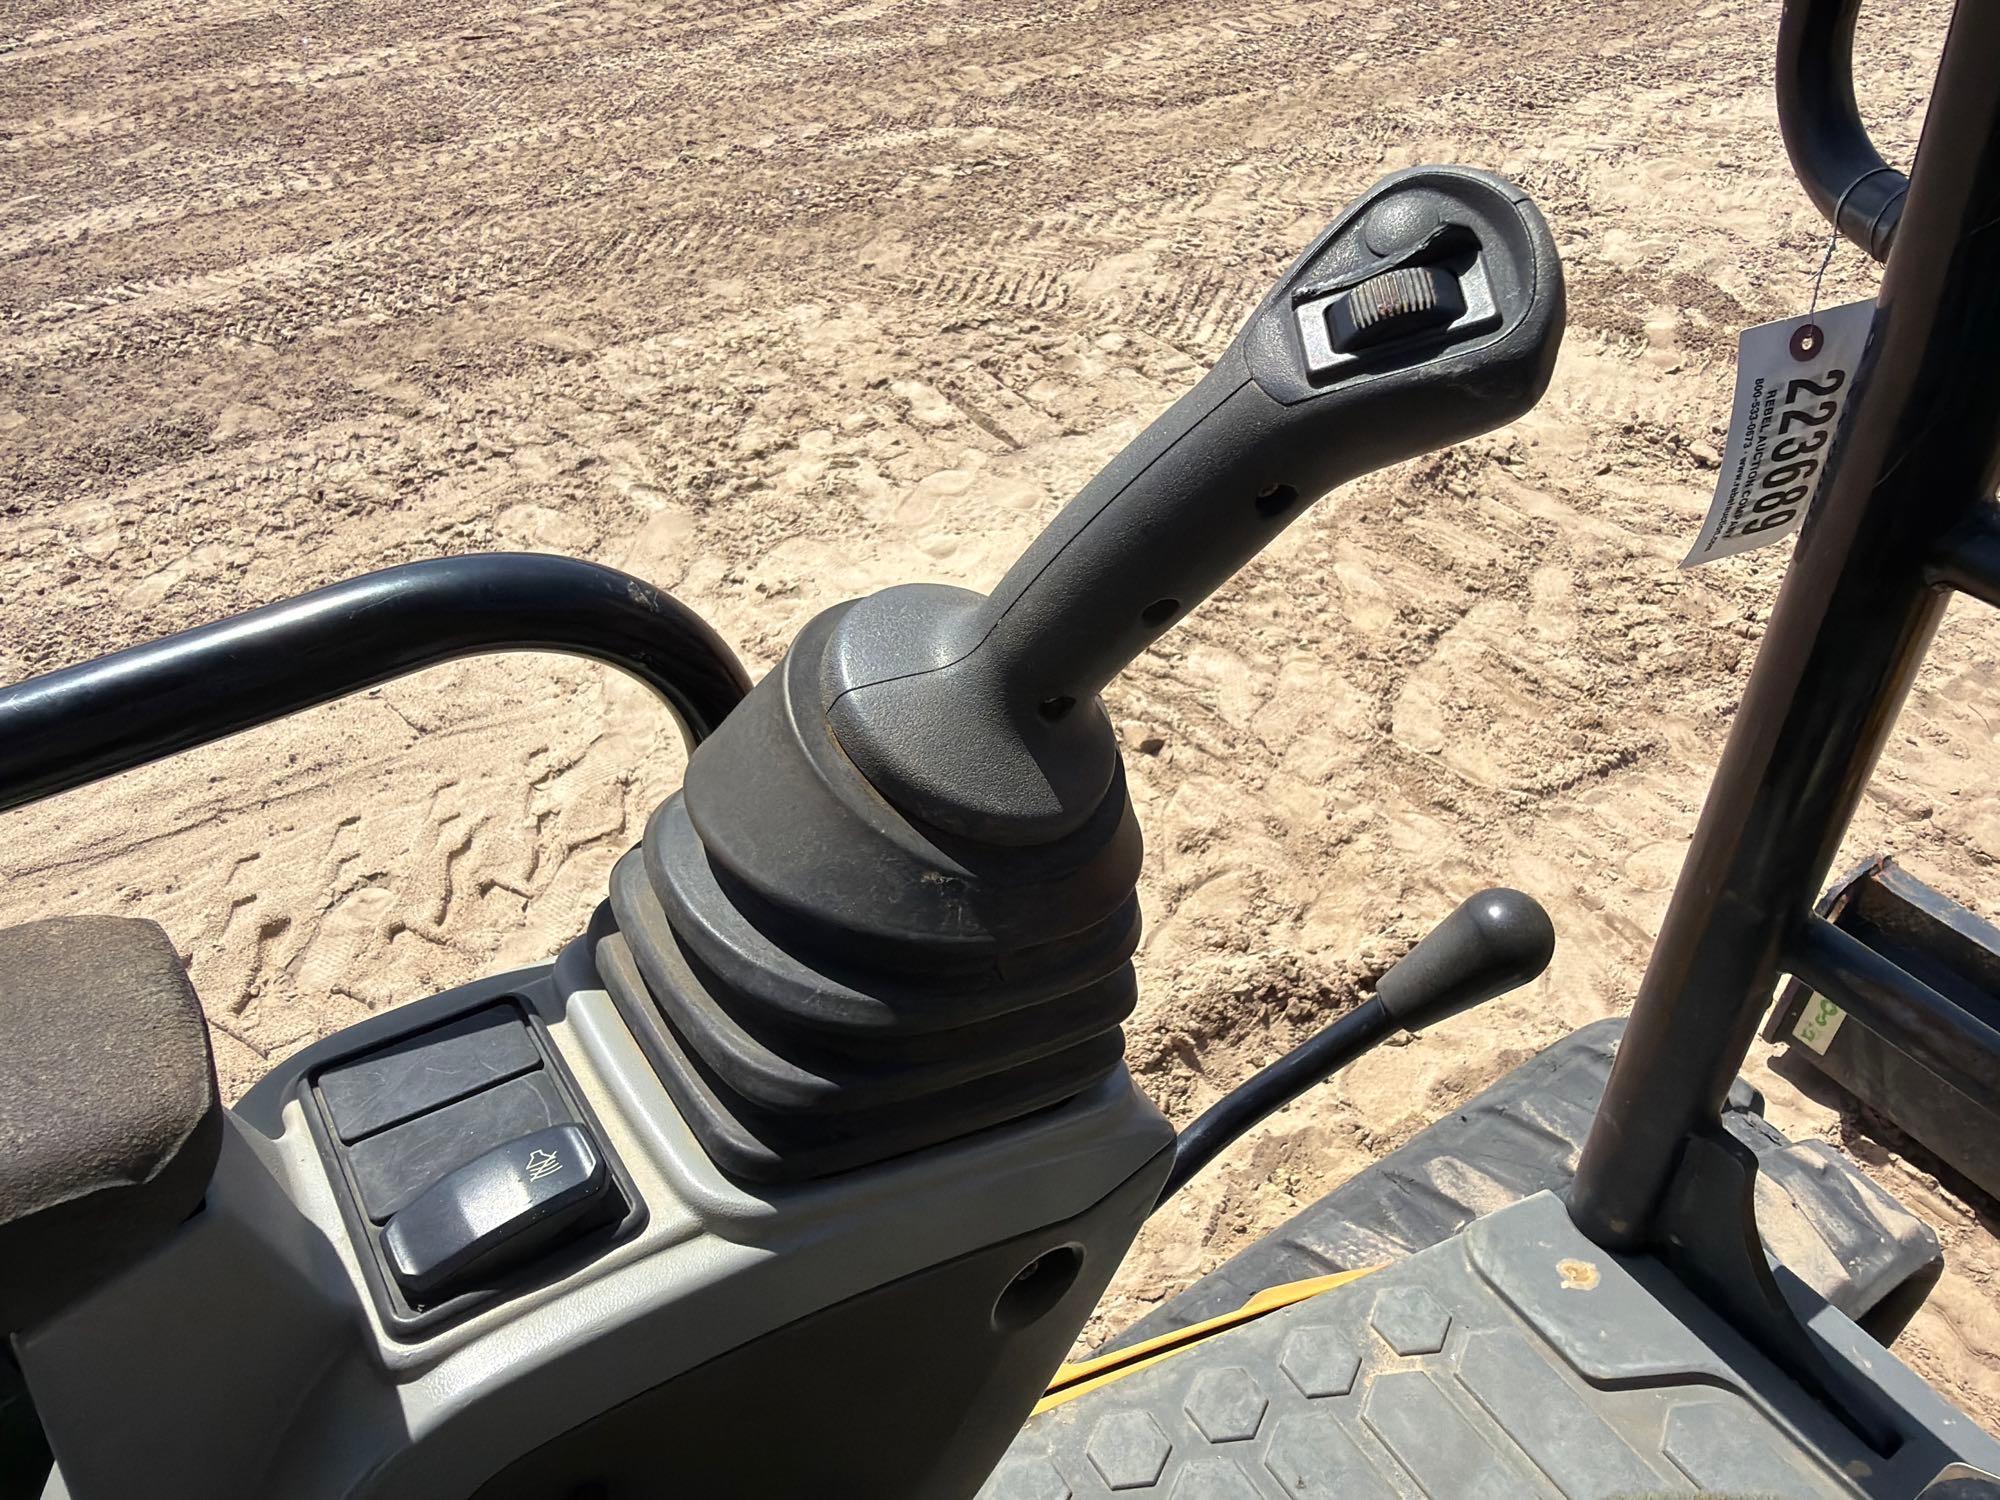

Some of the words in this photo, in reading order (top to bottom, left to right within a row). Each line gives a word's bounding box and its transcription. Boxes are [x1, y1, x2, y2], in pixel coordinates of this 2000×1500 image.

[1759, 389, 1777, 434] REBEL
[1742, 369, 1845, 536] 223689
[1747, 436, 1767, 487] AUCTION
